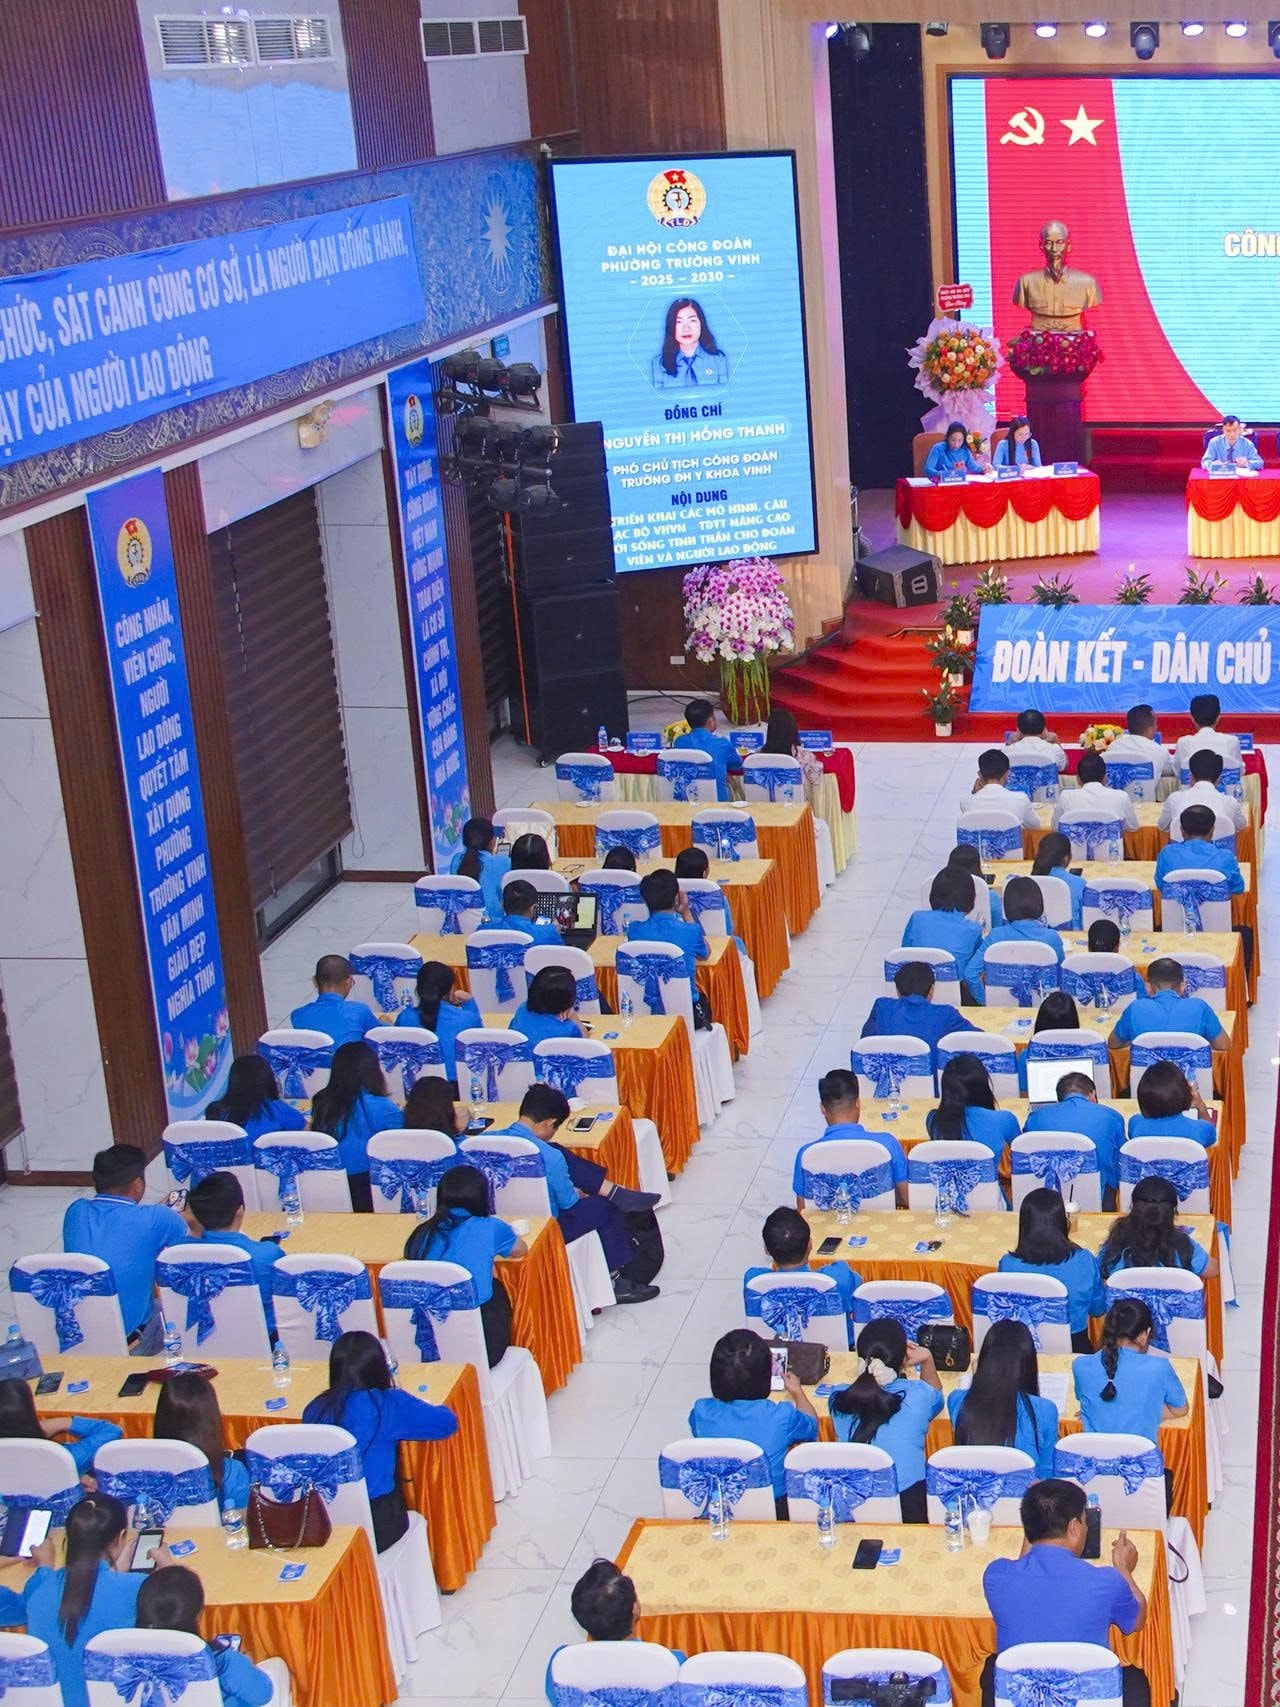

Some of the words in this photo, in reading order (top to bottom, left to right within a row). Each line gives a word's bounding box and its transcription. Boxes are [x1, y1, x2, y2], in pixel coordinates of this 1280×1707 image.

[607, 244, 632, 259] ĐẠI
[637, 240, 662, 257] HỘI
[666, 238, 708, 253] CÔNG
[712, 236, 752, 251] ĐOÀN
[601, 258, 661, 273] PHƯỜNG
[666, 255, 723, 269] TRƯỜNG
[728, 253, 760, 266] VINH
[53, 283, 93, 346] SÁT
[95, 275, 148, 336] CÁNH
[147, 264, 196, 323] CÙNG
[195, 259, 219, 310] CƠ
[247, 244, 269, 296] LÀ
[267, 233, 311, 290] NGƯỜI
[310, 235, 339, 286] BẠN
[338, 217, 373, 271] ĐỒNG
[641, 274, 673, 286] 2025
[691, 271, 723, 284] 2030
[26, 363, 72, 435] CỦA
[69, 350, 132, 421] NGƯỜI
[130, 349, 166, 402] LAO
[165, 332, 215, 397] ĐỘNG
[702, 402, 722, 418] CHÍ
[603, 432, 660, 450] NGUYỄN
[664, 431, 687, 446] THỊ
[737, 423, 785, 437] THANH
[613, 460, 639, 476] PHÓ
[672, 458, 699, 473] TỊCH
[703, 453, 740, 467] CÔNG
[743, 450, 778, 464] ĐOÀN
[694, 471, 703, 482] Y
[706, 467, 740, 480] KHOA
[743, 464, 772, 476] VINH
[671, 491, 692, 507] NỘI
[696, 489, 728, 503] DUNG
[613, 529, 631, 541] ẠC
[654, 523, 686, 535] VHVN
[767, 512, 791, 523] CAO
[647, 511, 677, 523] KHAI
[614, 541, 627, 554] ỜI
[668, 536, 697, 548] TINH
[734, 529, 759, 540] CHO
[718, 544, 740, 556] LAO
[115, 612, 144, 648] CÔNG
[122, 650, 147, 686] VIÊN
[992, 631, 1069, 683] ĐOÀN
[1075, 627, 1128, 683] KẾT
[1151, 632, 1209, 684] DÂN
[1216, 627, 1271, 685] CHỦ
[136, 728, 155, 761] LAO
[155, 712, 182, 751] ĐỘNG
[146, 801, 165, 837] XÂY
[185, 853, 207, 889] VINH
[180, 894, 205, 933] MINH
